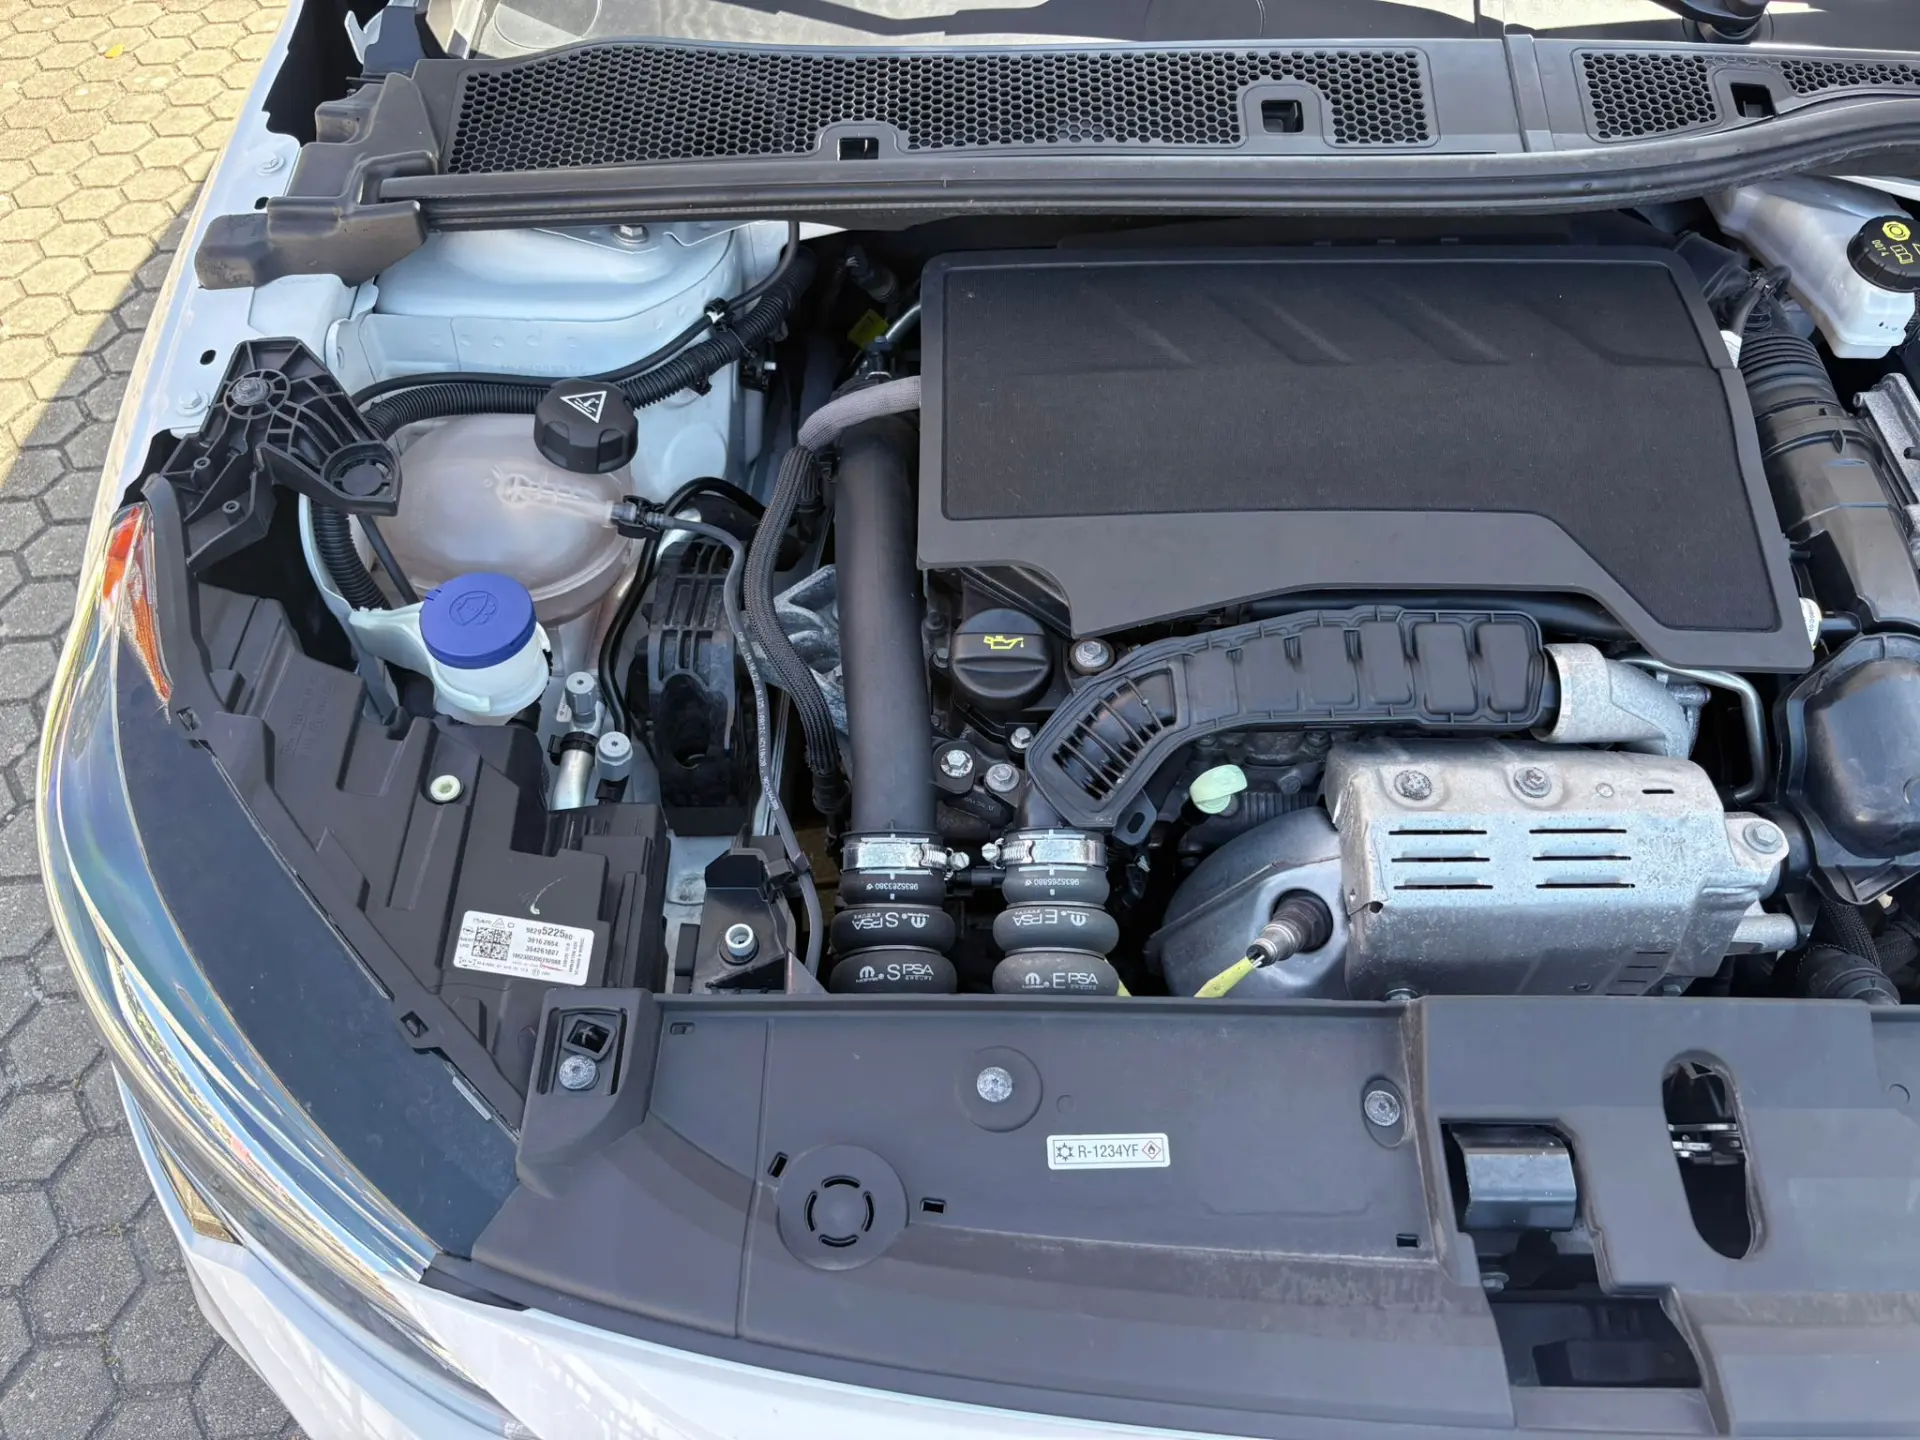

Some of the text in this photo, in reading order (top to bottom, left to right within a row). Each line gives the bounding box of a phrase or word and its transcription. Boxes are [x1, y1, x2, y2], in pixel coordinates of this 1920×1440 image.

[852, 917, 883, 930] PSA
[885, 911, 899, 928] S
[1012, 913, 1043, 927] PSA
[1044, 909, 1058, 924] E
[886, 963, 901, 981] S
[902, 963, 934, 975] PSA
[1052, 972, 1066, 989] E
[1068, 971, 1099, 985] PSA
[1078, 1143, 1139, 1158] R-1234YF
